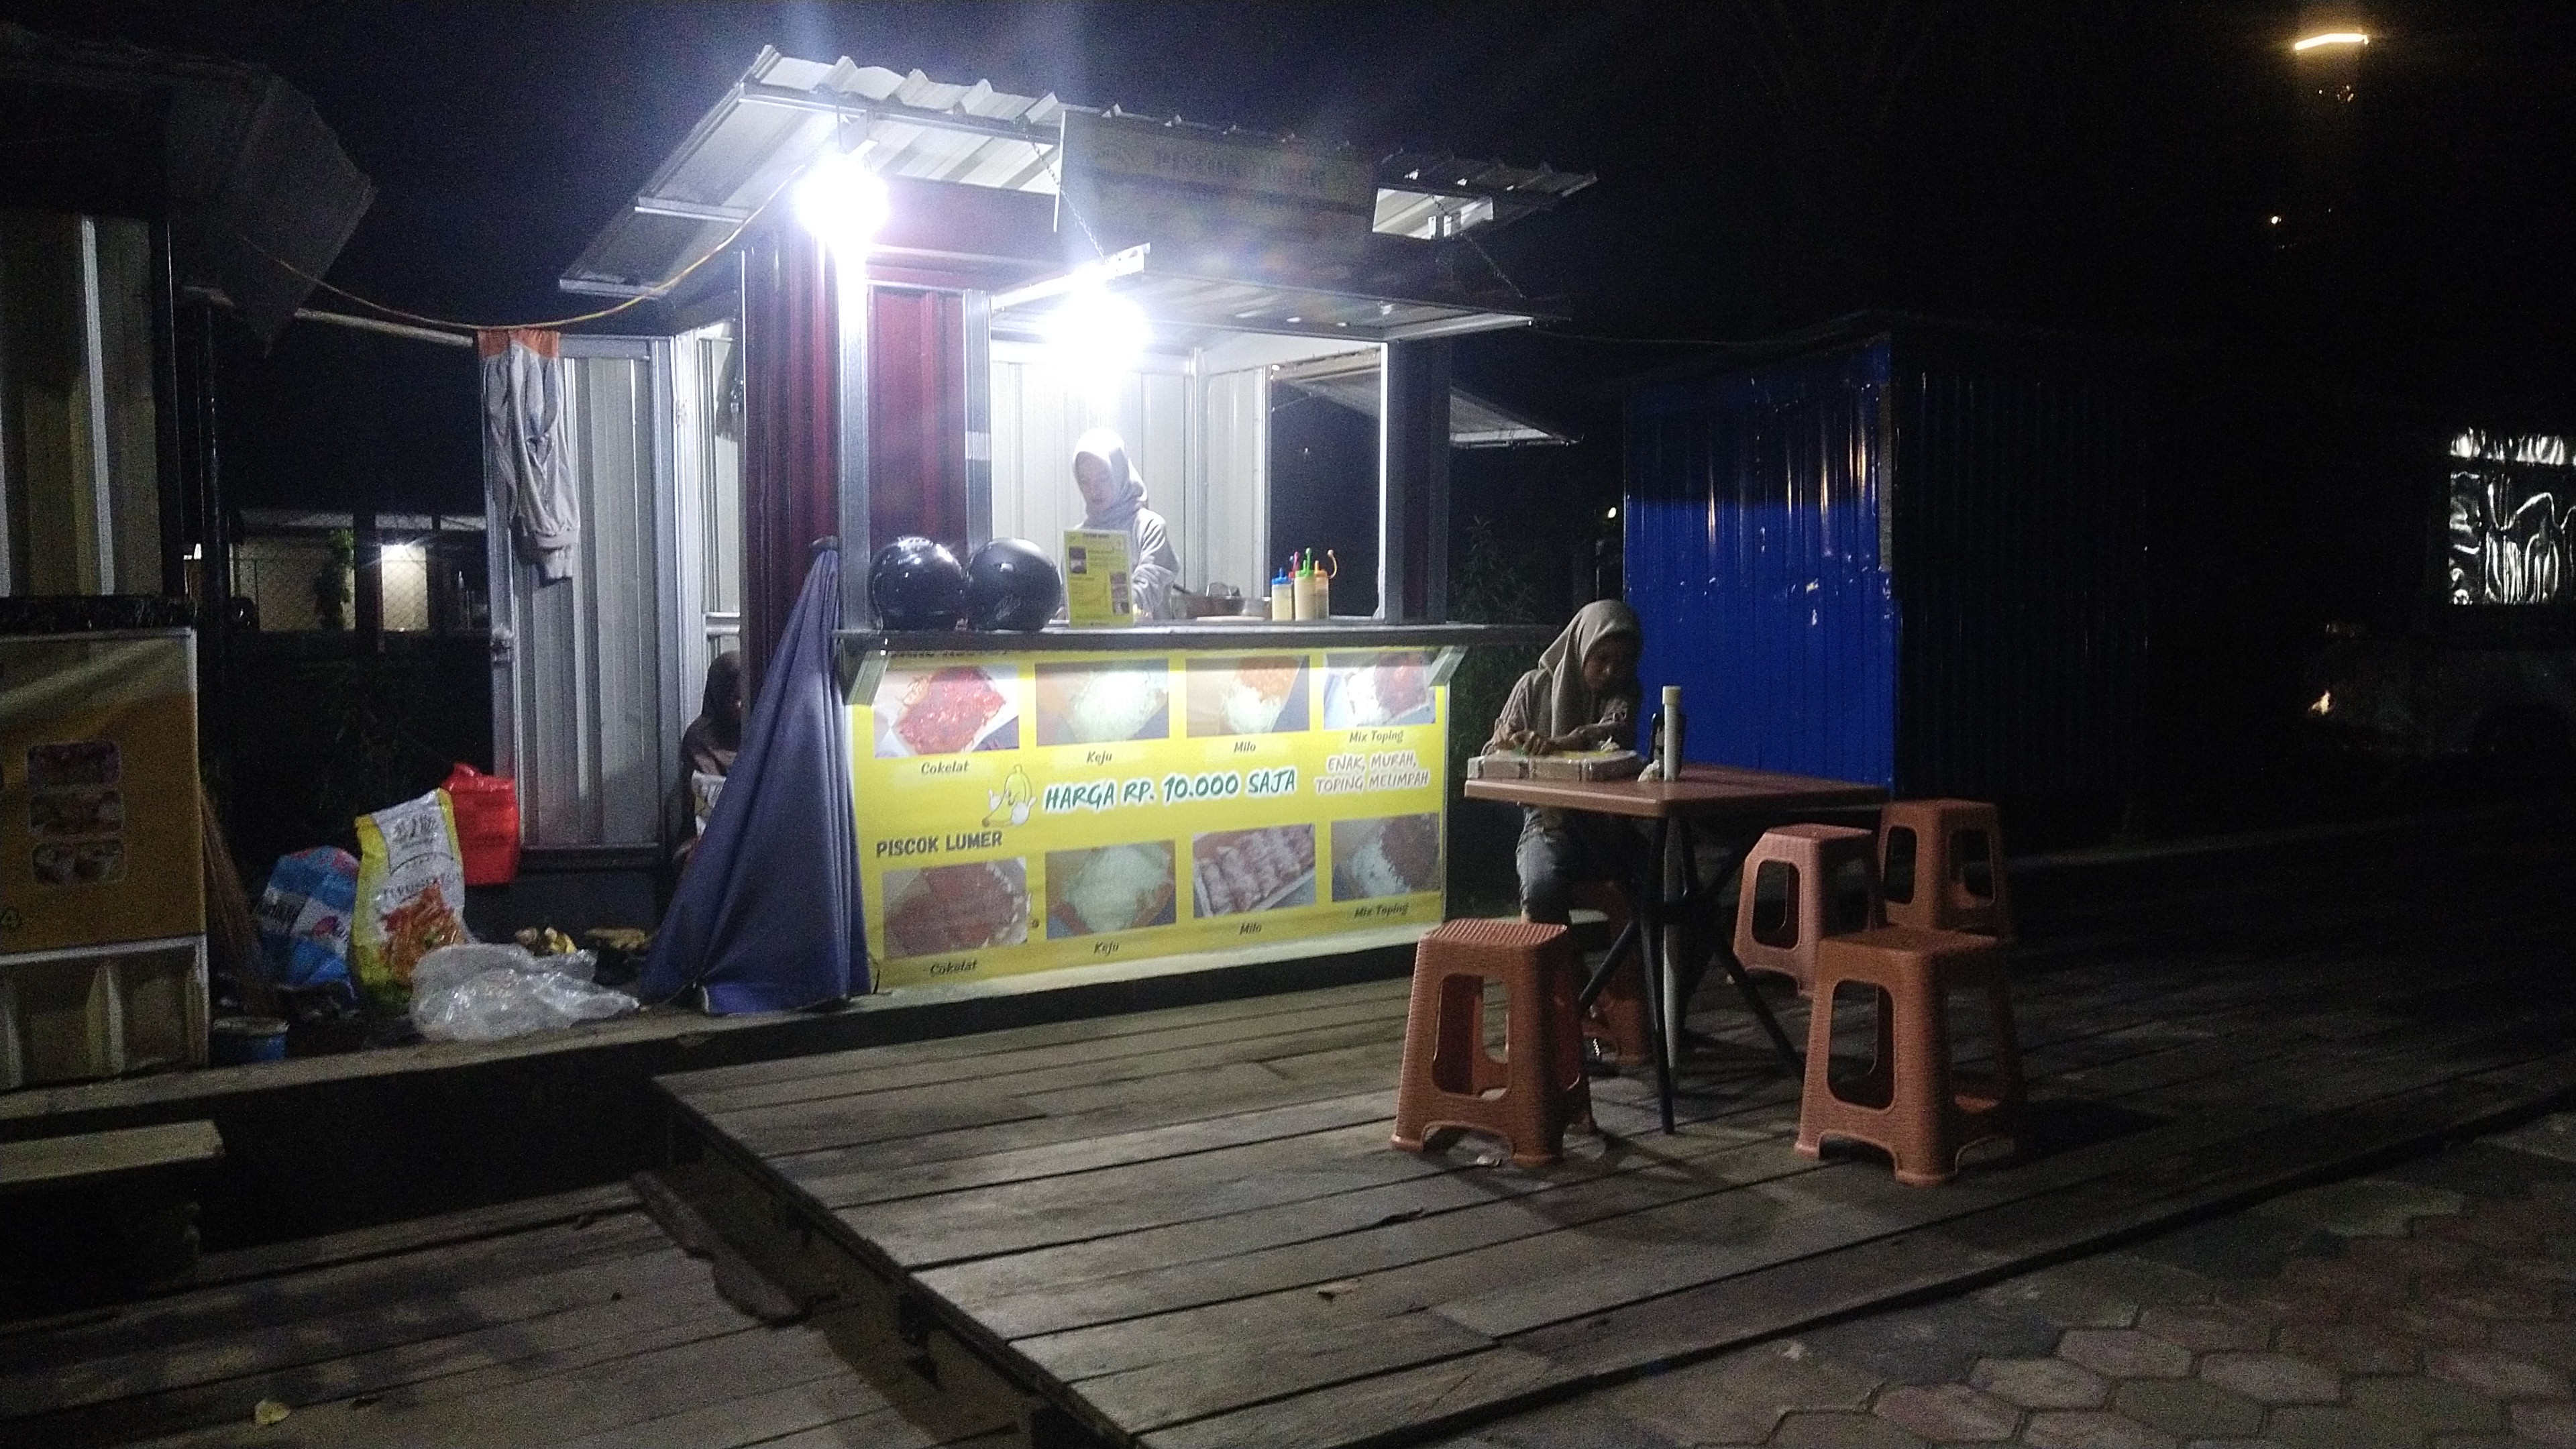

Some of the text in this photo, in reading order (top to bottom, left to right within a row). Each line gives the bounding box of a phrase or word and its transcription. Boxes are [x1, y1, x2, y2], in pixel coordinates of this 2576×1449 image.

[1350, 730, 1403, 743] Mix Toping
[1234, 742, 1256, 753] Milo
[1086, 751, 1112, 763] Keju
[1328, 755, 1365, 770] ENAK,
[921, 761, 969, 775] Cokelat
[1316, 771, 1429, 793] TOPING MELIMPAH
[1045, 769, 1295, 810] HARGA RP. 10.000 SAJA
[876, 830, 1003, 857] PISCOK LUMER
